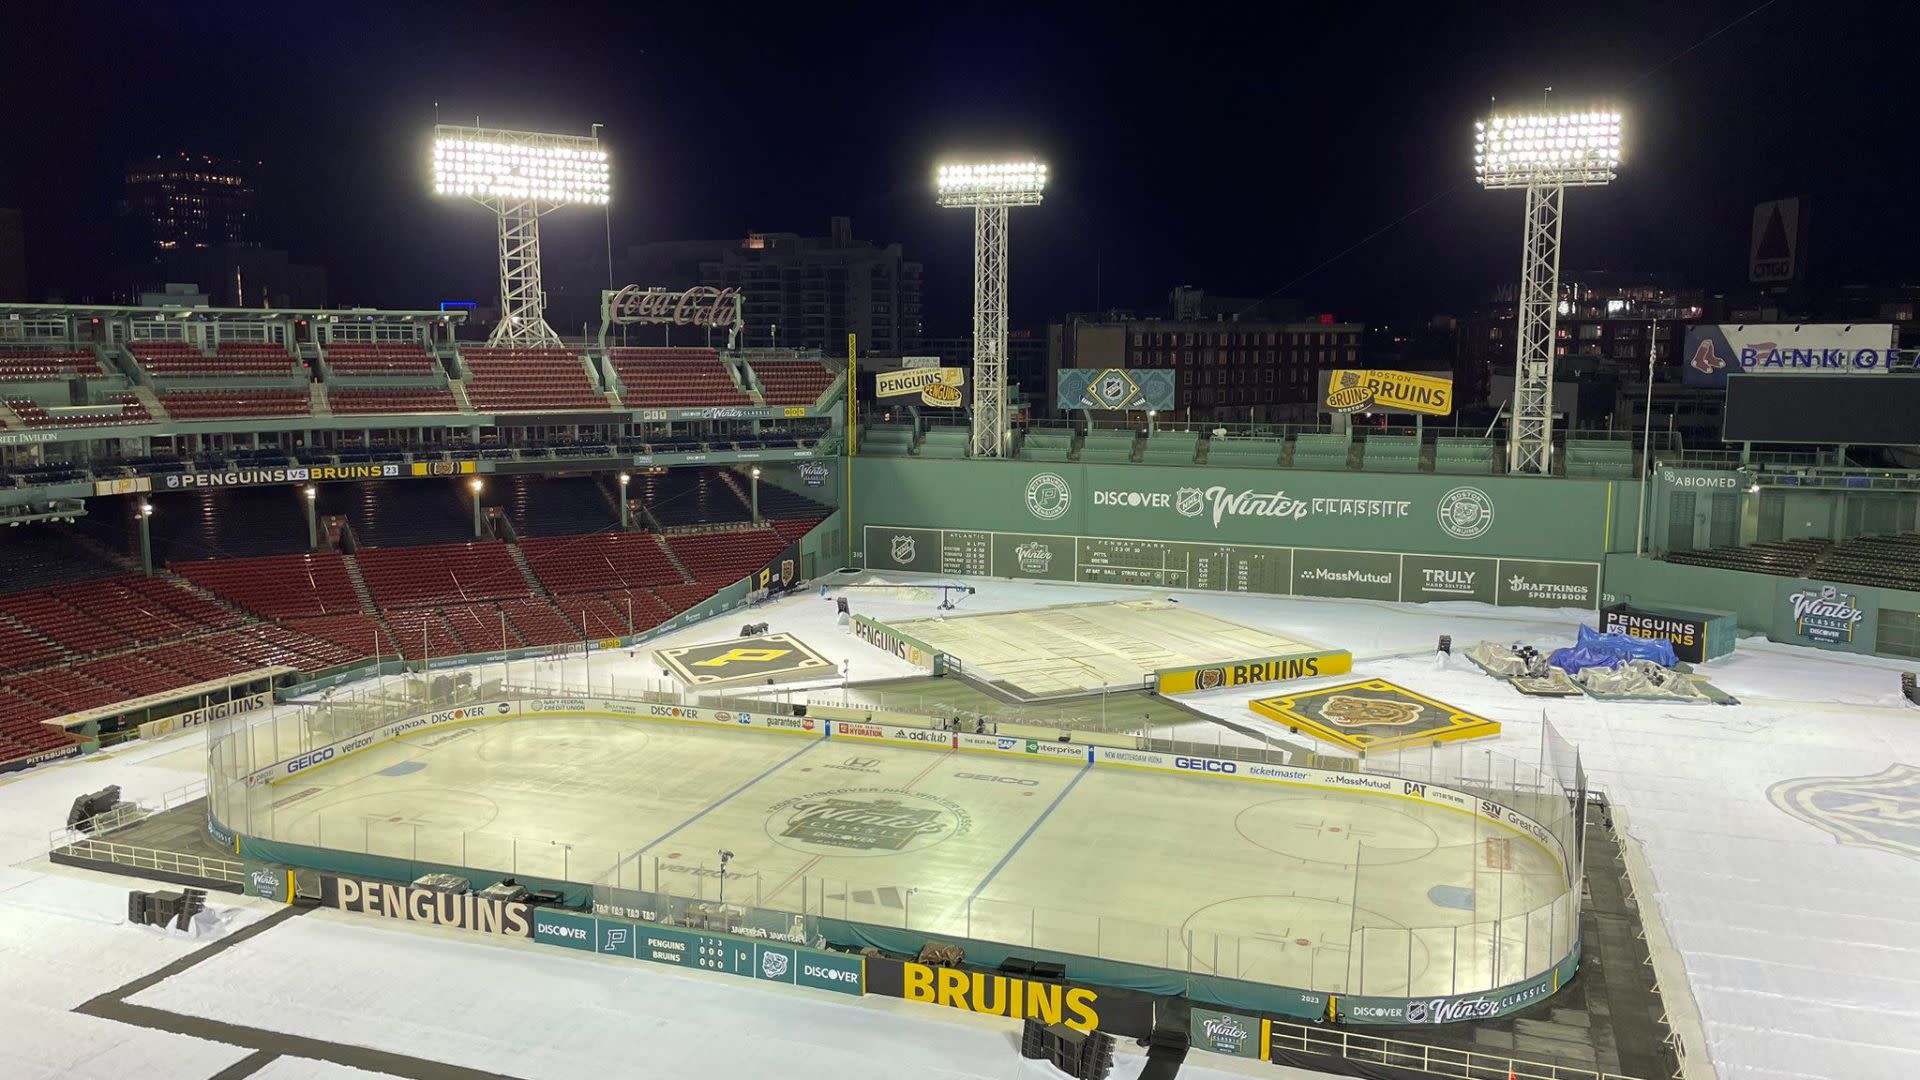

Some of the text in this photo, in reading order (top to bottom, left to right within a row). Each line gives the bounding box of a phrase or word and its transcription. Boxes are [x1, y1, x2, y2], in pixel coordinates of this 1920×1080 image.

[1741, 348, 1842, 369] BANK
[1855, 348, 1902, 369] OF
[880, 373, 942, 392] PENGUINS
[1369, 370, 1411, 382] BOSTON
[925, 383, 959, 400] PENGUINS
[1329, 389, 1369, 406] BRUINS
[1367, 379, 1446, 407] BRUINS
[1338, 403, 1365, 413] BOSTON
[20, 433, 57, 441] PAVILION
[182, 466, 397, 487] PENGUINS VS BRUINS 23
[1675, 477, 1736, 488] ABIOMED
[1451, 492, 1481, 501] BOSTON
[1094, 491, 1170, 508] DISCOVER
[1205, 486, 1308, 528] Winter
[1312, 498, 1411, 517] CLASSIC
[1316, 568, 1392, 584] MassMutual
[1422, 569, 1476, 583] TRULY
[1510, 577, 1588, 593] DRAFTKINGS
[1529, 591, 1587, 601] SPORTSBOOK
[1602, 593, 1615, 602] 379
[1790, 593, 1862, 622] Winter
[1607, 612, 1695, 635] PENGUINS
[1804, 617, 1848, 629] CLASSIC
[856, 619, 906, 660] PENGUINS
[1609, 626, 1694, 646] VS BRUINS
[1809, 627, 1840, 637] DISCOVER
[1233, 657, 1319, 687] BRUINS
[182, 694, 264, 729] PENGUINS
[431, 707, 485, 724] DISCOVER
[651, 706, 698, 719] DISCOVER
[391, 719, 428, 734] HONDA
[766, 717, 800, 727] guaranteed
[341, 734, 374, 754] verizon
[909, 732, 947, 743] adiclub
[26, 747, 78, 765] PITTSBURGH
[1028, 742, 1081, 756] enterprise
[287, 748, 334, 774] GEICO
[823, 764, 880, 773] HONDA
[1175, 757, 1236, 774] GEICO
[954, 772, 1039, 787] GEICO
[1250, 766, 1307, 780] ticketmaster
[1336, 775, 1391, 790] MassMutual
[1404, 781, 1427, 799] CAT
[803, 787, 879, 799] DISCOVER
[1482, 801, 1502, 815] SN
[788, 801, 947, 835] Winter
[1508, 812, 1531, 833] Great
[809, 821, 900, 837] CLASSIC
[813, 832, 877, 844] DISCOVER
[251, 872, 280, 887] Winter
[337, 877, 530, 938] PENGUINS
[538, 923, 586, 940] DISCOVER
[605, 928, 627, 950] P
[647, 937, 723, 957] PENGUINS 0 0 0
[652, 951, 746, 969] BRUINS 0 0 0 0
[804, 965, 858, 984] DISCOVER
[904, 961, 1098, 1031] BRUINS
[1300, 995, 1319, 1004] 2023
[1353, 1006, 1402, 1018] DISCOVER
[1429, 997, 1500, 1024] Winter
[1502, 983, 1546, 1009] CLASSIC
[1203, 1020, 1248, 1039] Winter
